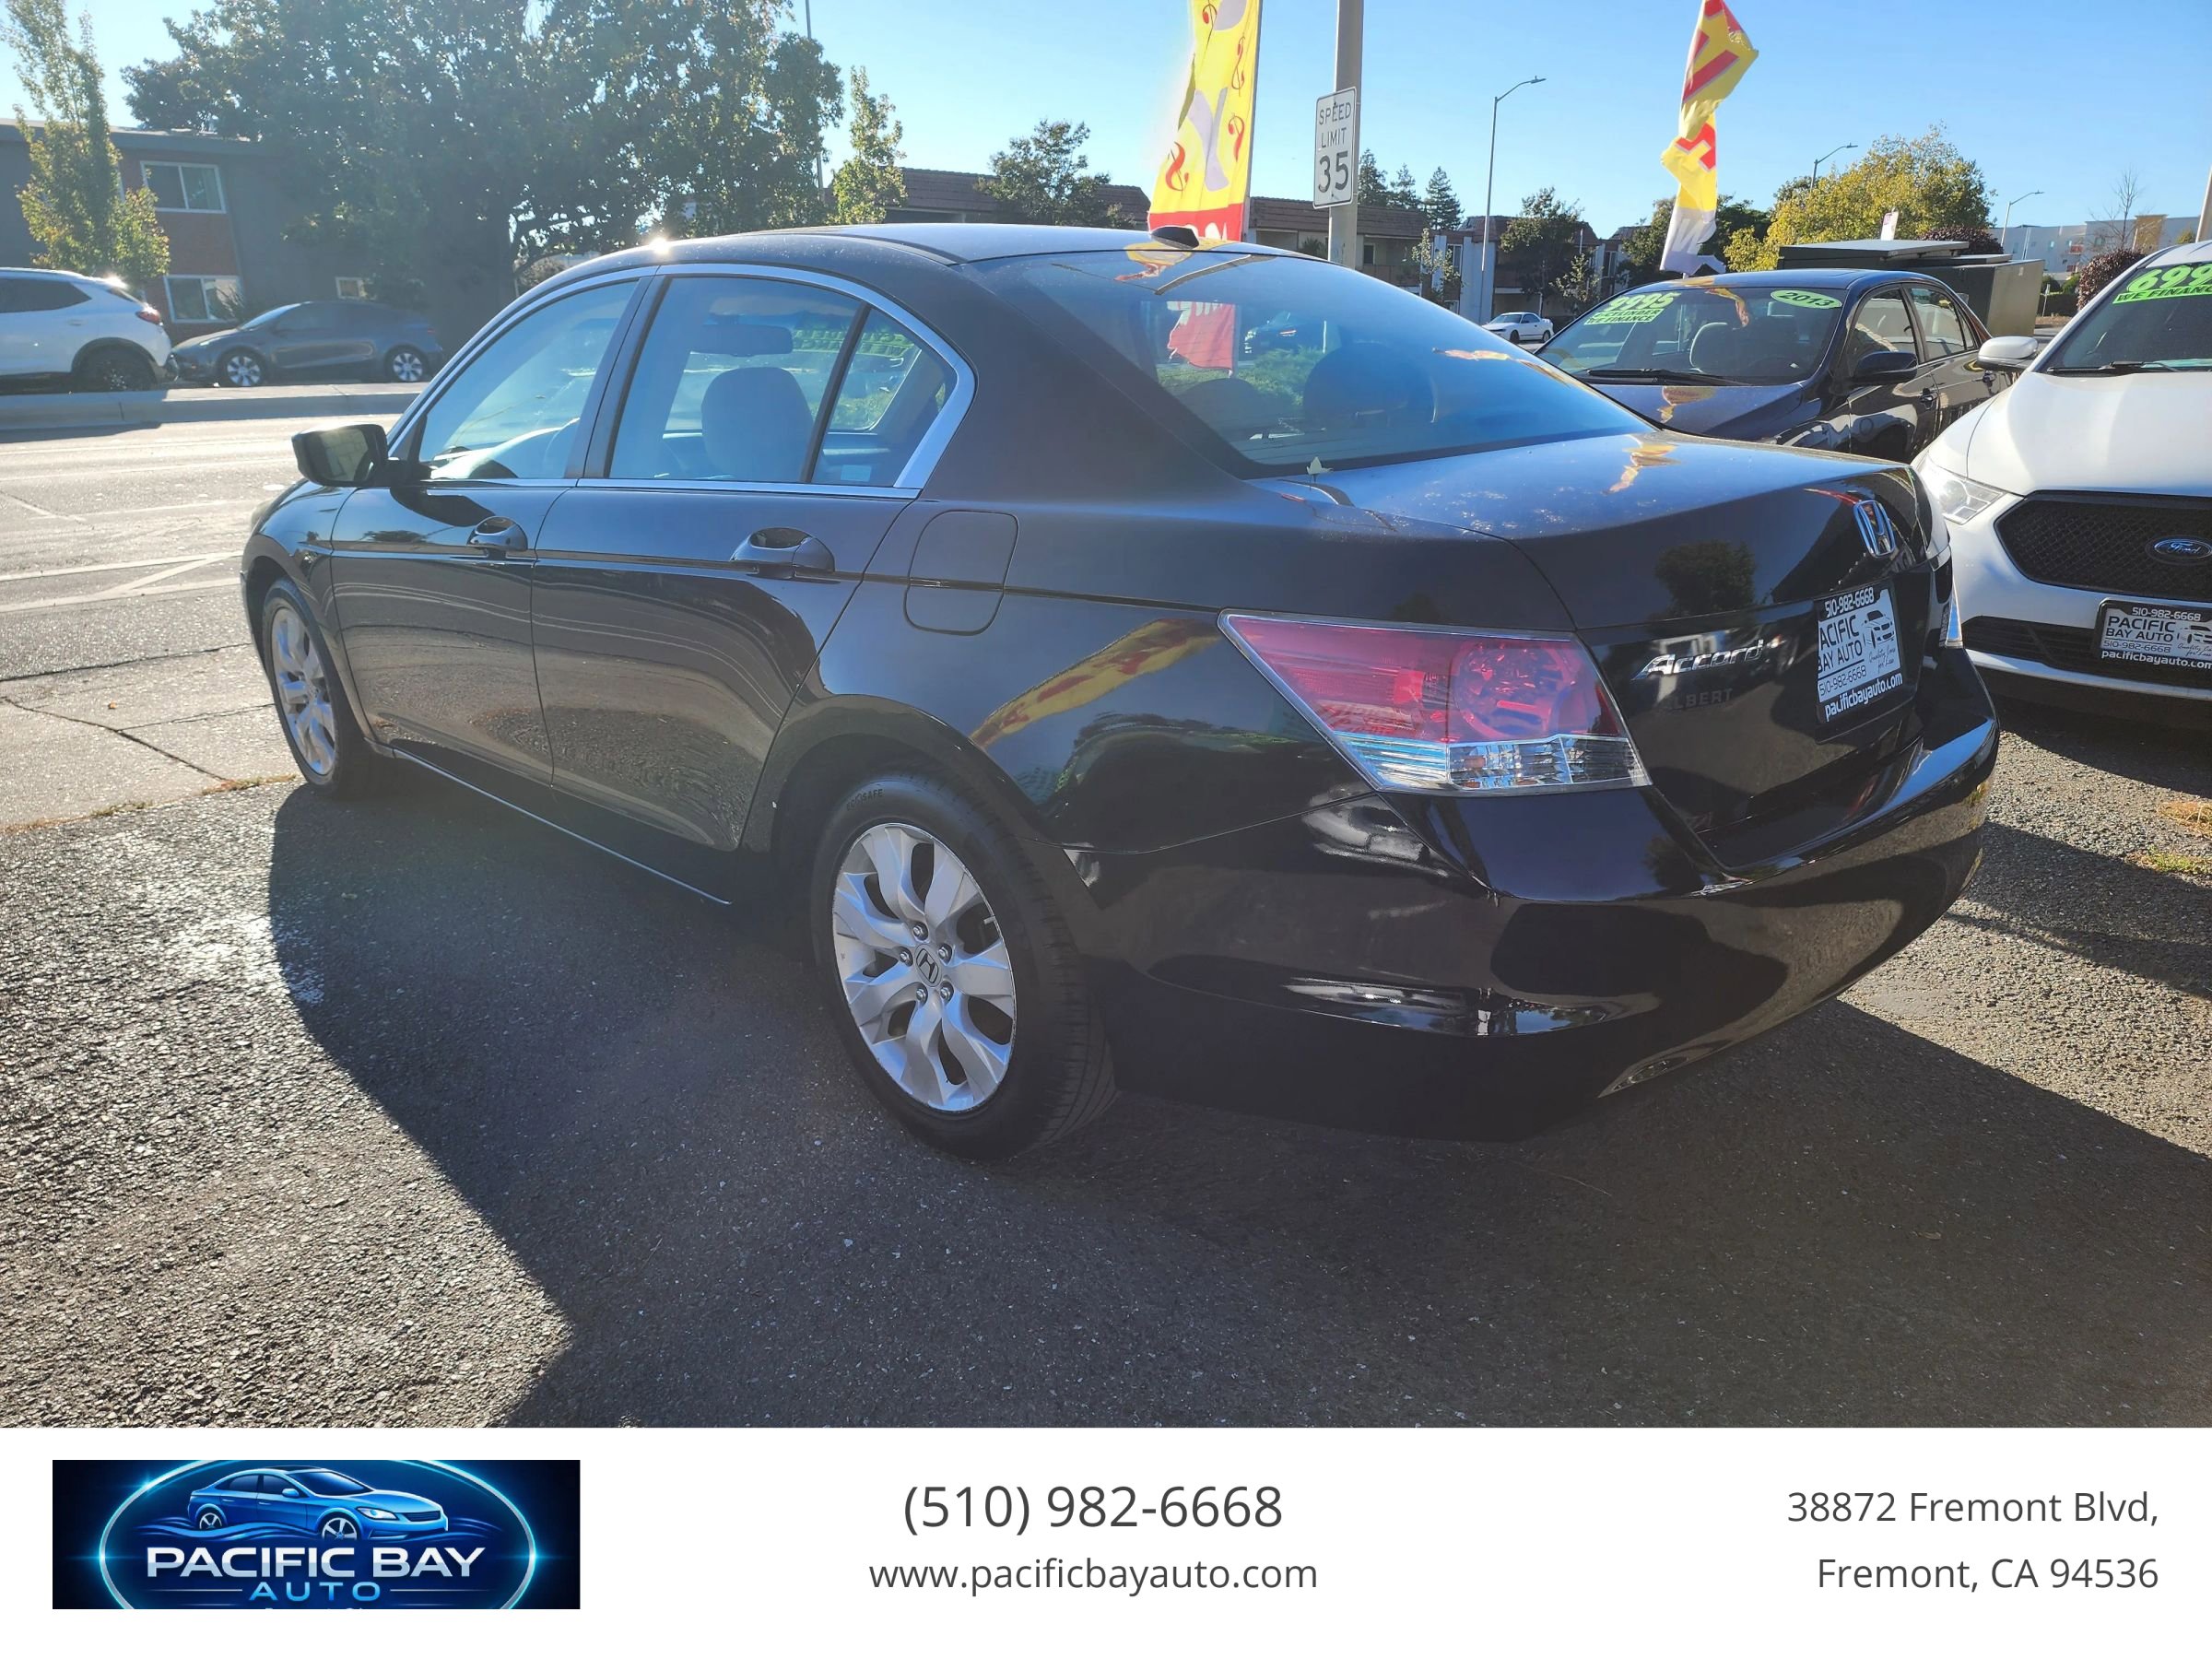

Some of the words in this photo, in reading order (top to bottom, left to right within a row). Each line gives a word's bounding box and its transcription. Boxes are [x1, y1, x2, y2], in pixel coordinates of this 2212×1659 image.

[1319, 102, 1352, 125] SPEED
[1321, 127, 1347, 148] LIMIT
[1318, 150, 1349, 194] 35
[1604, 292, 1681, 312] 9995
[1778, 292, 1835, 307] 2013
[2167, 541, 2202, 554] Ford
[1825, 587, 1874, 618] 510-982-6668
[2108, 616, 2177, 633] PACIFIC
[2132, 607, 2201, 621] 510-982-6668
[1819, 615, 1860, 651] ACIFIC
[2105, 628, 2133, 639] BAY
[2136, 631, 2173, 642] AUTO
[1838, 640, 1863, 665] AUTO
[2103, 640, 2171, 653] 510-982-6668
[1630, 640, 1764, 680] Accord
[2101, 650, 2212, 669] pacificbayauto.com
[1818, 665, 1867, 696] 510-982-6668
[1825, 673, 1902, 722] pacificbayauto.com
